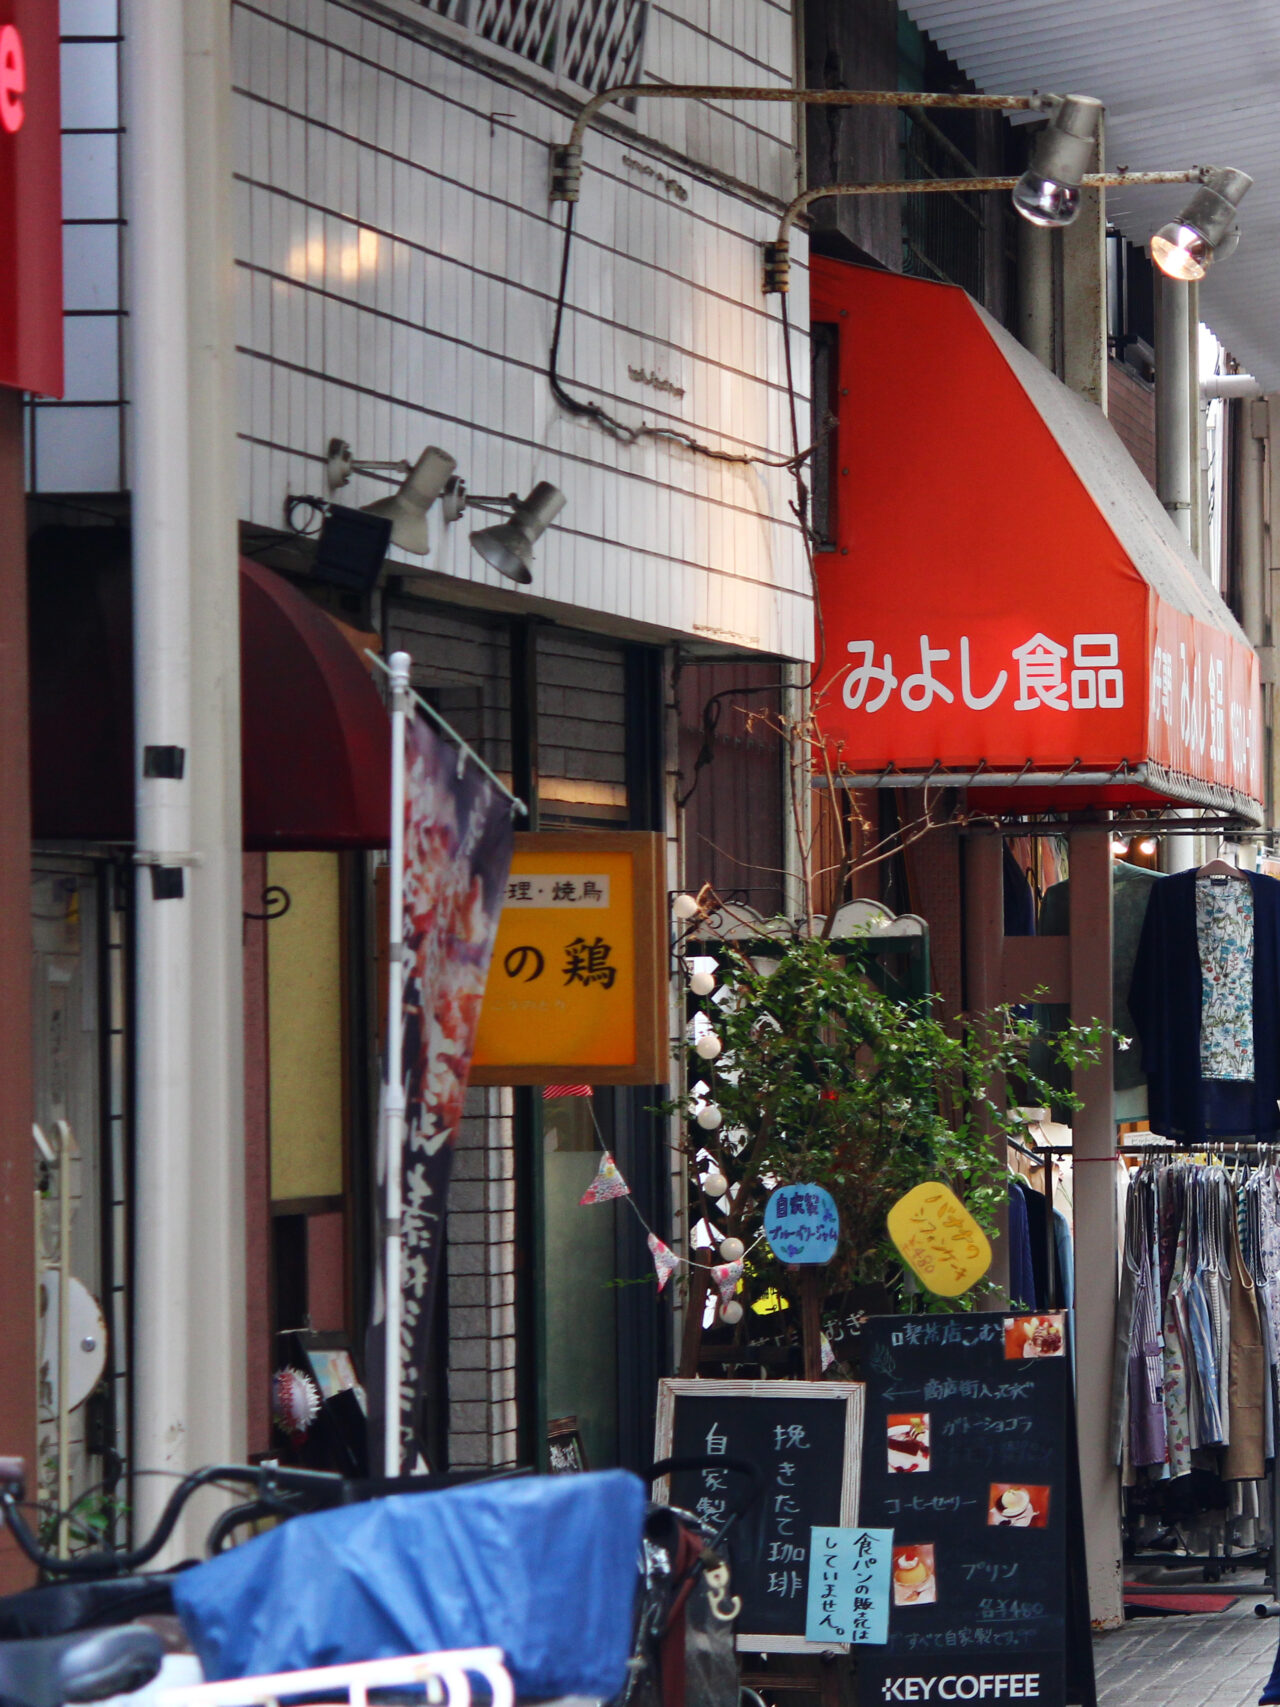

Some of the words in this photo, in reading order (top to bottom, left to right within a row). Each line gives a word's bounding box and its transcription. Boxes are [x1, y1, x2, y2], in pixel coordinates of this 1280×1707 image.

[843, 632, 1124, 713] みよし食品
[504, 881, 603, 902] 理・焼鳥
[776, 1192, 820, 1219] 自家製
[891, 1320, 1004, 1347] 喫茶店こむ
[768, 1424, 811, 1600] 挽きたて珈琲
[819, 1537, 845, 1636] していません。
[852, 1532, 881, 1642] 食パンの販売は
[961, 1560, 1019, 1583] プリン
